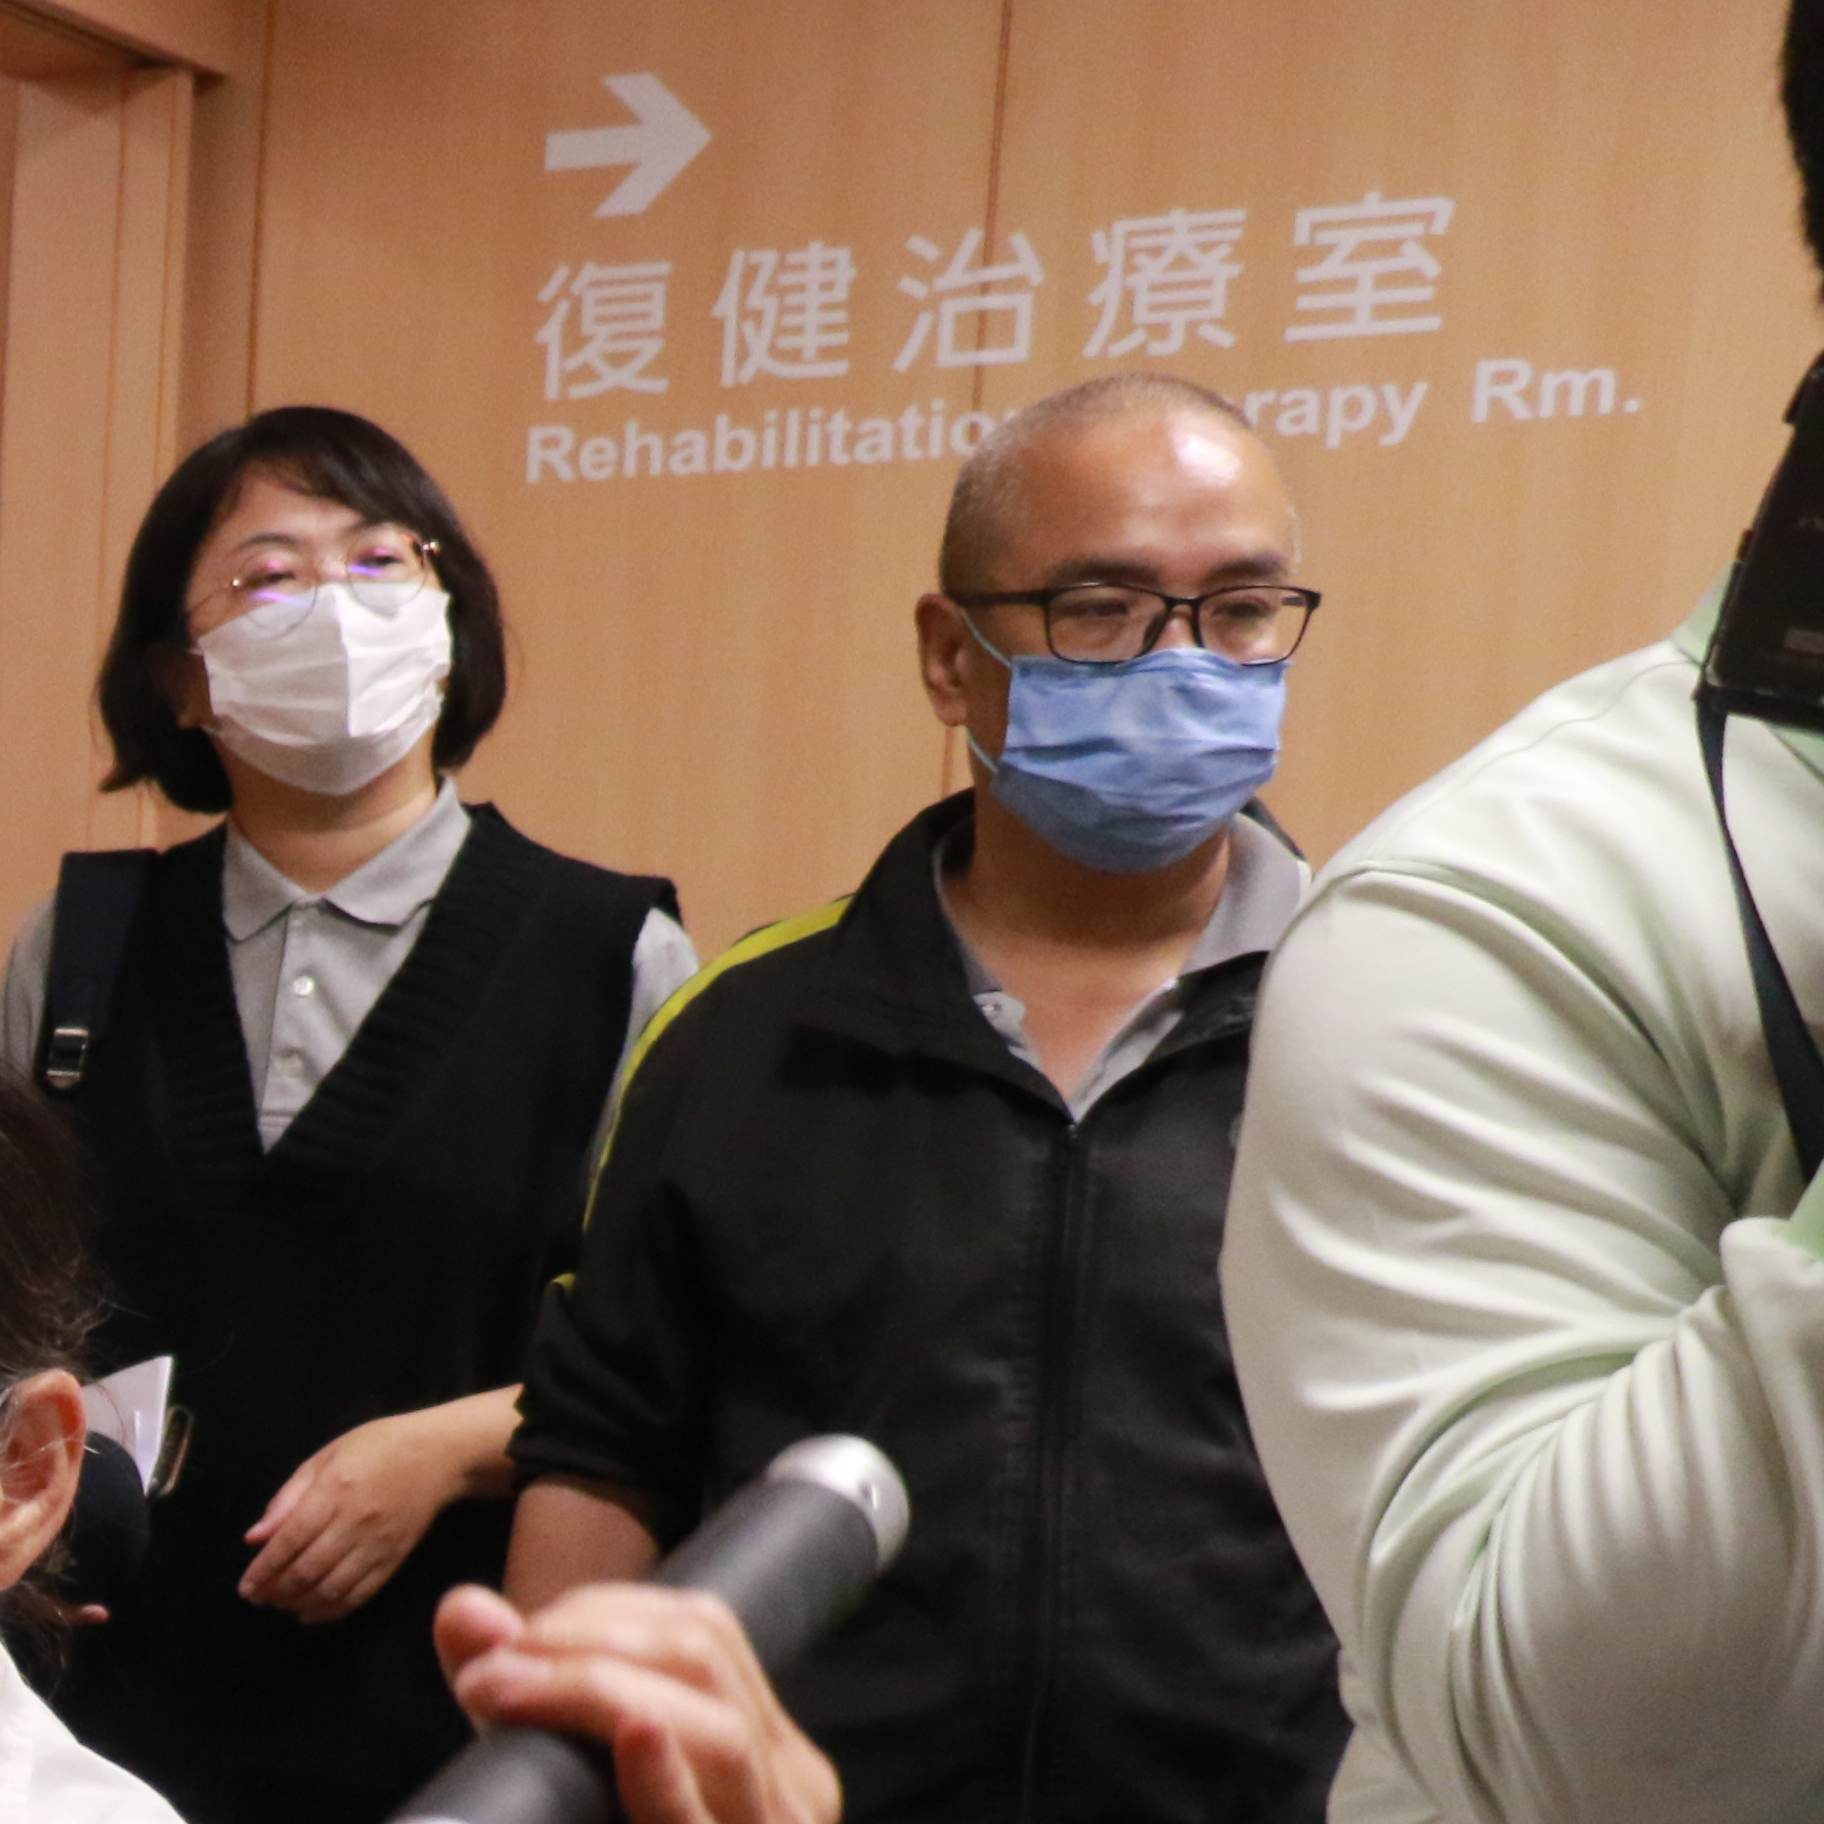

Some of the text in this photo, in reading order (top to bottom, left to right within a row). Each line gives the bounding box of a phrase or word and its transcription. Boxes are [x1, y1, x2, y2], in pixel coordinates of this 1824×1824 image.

[534, 188, 1456, 400] 復健治療室
[525, 357, 1644, 485] Rehabilitatio rapy Rm.
